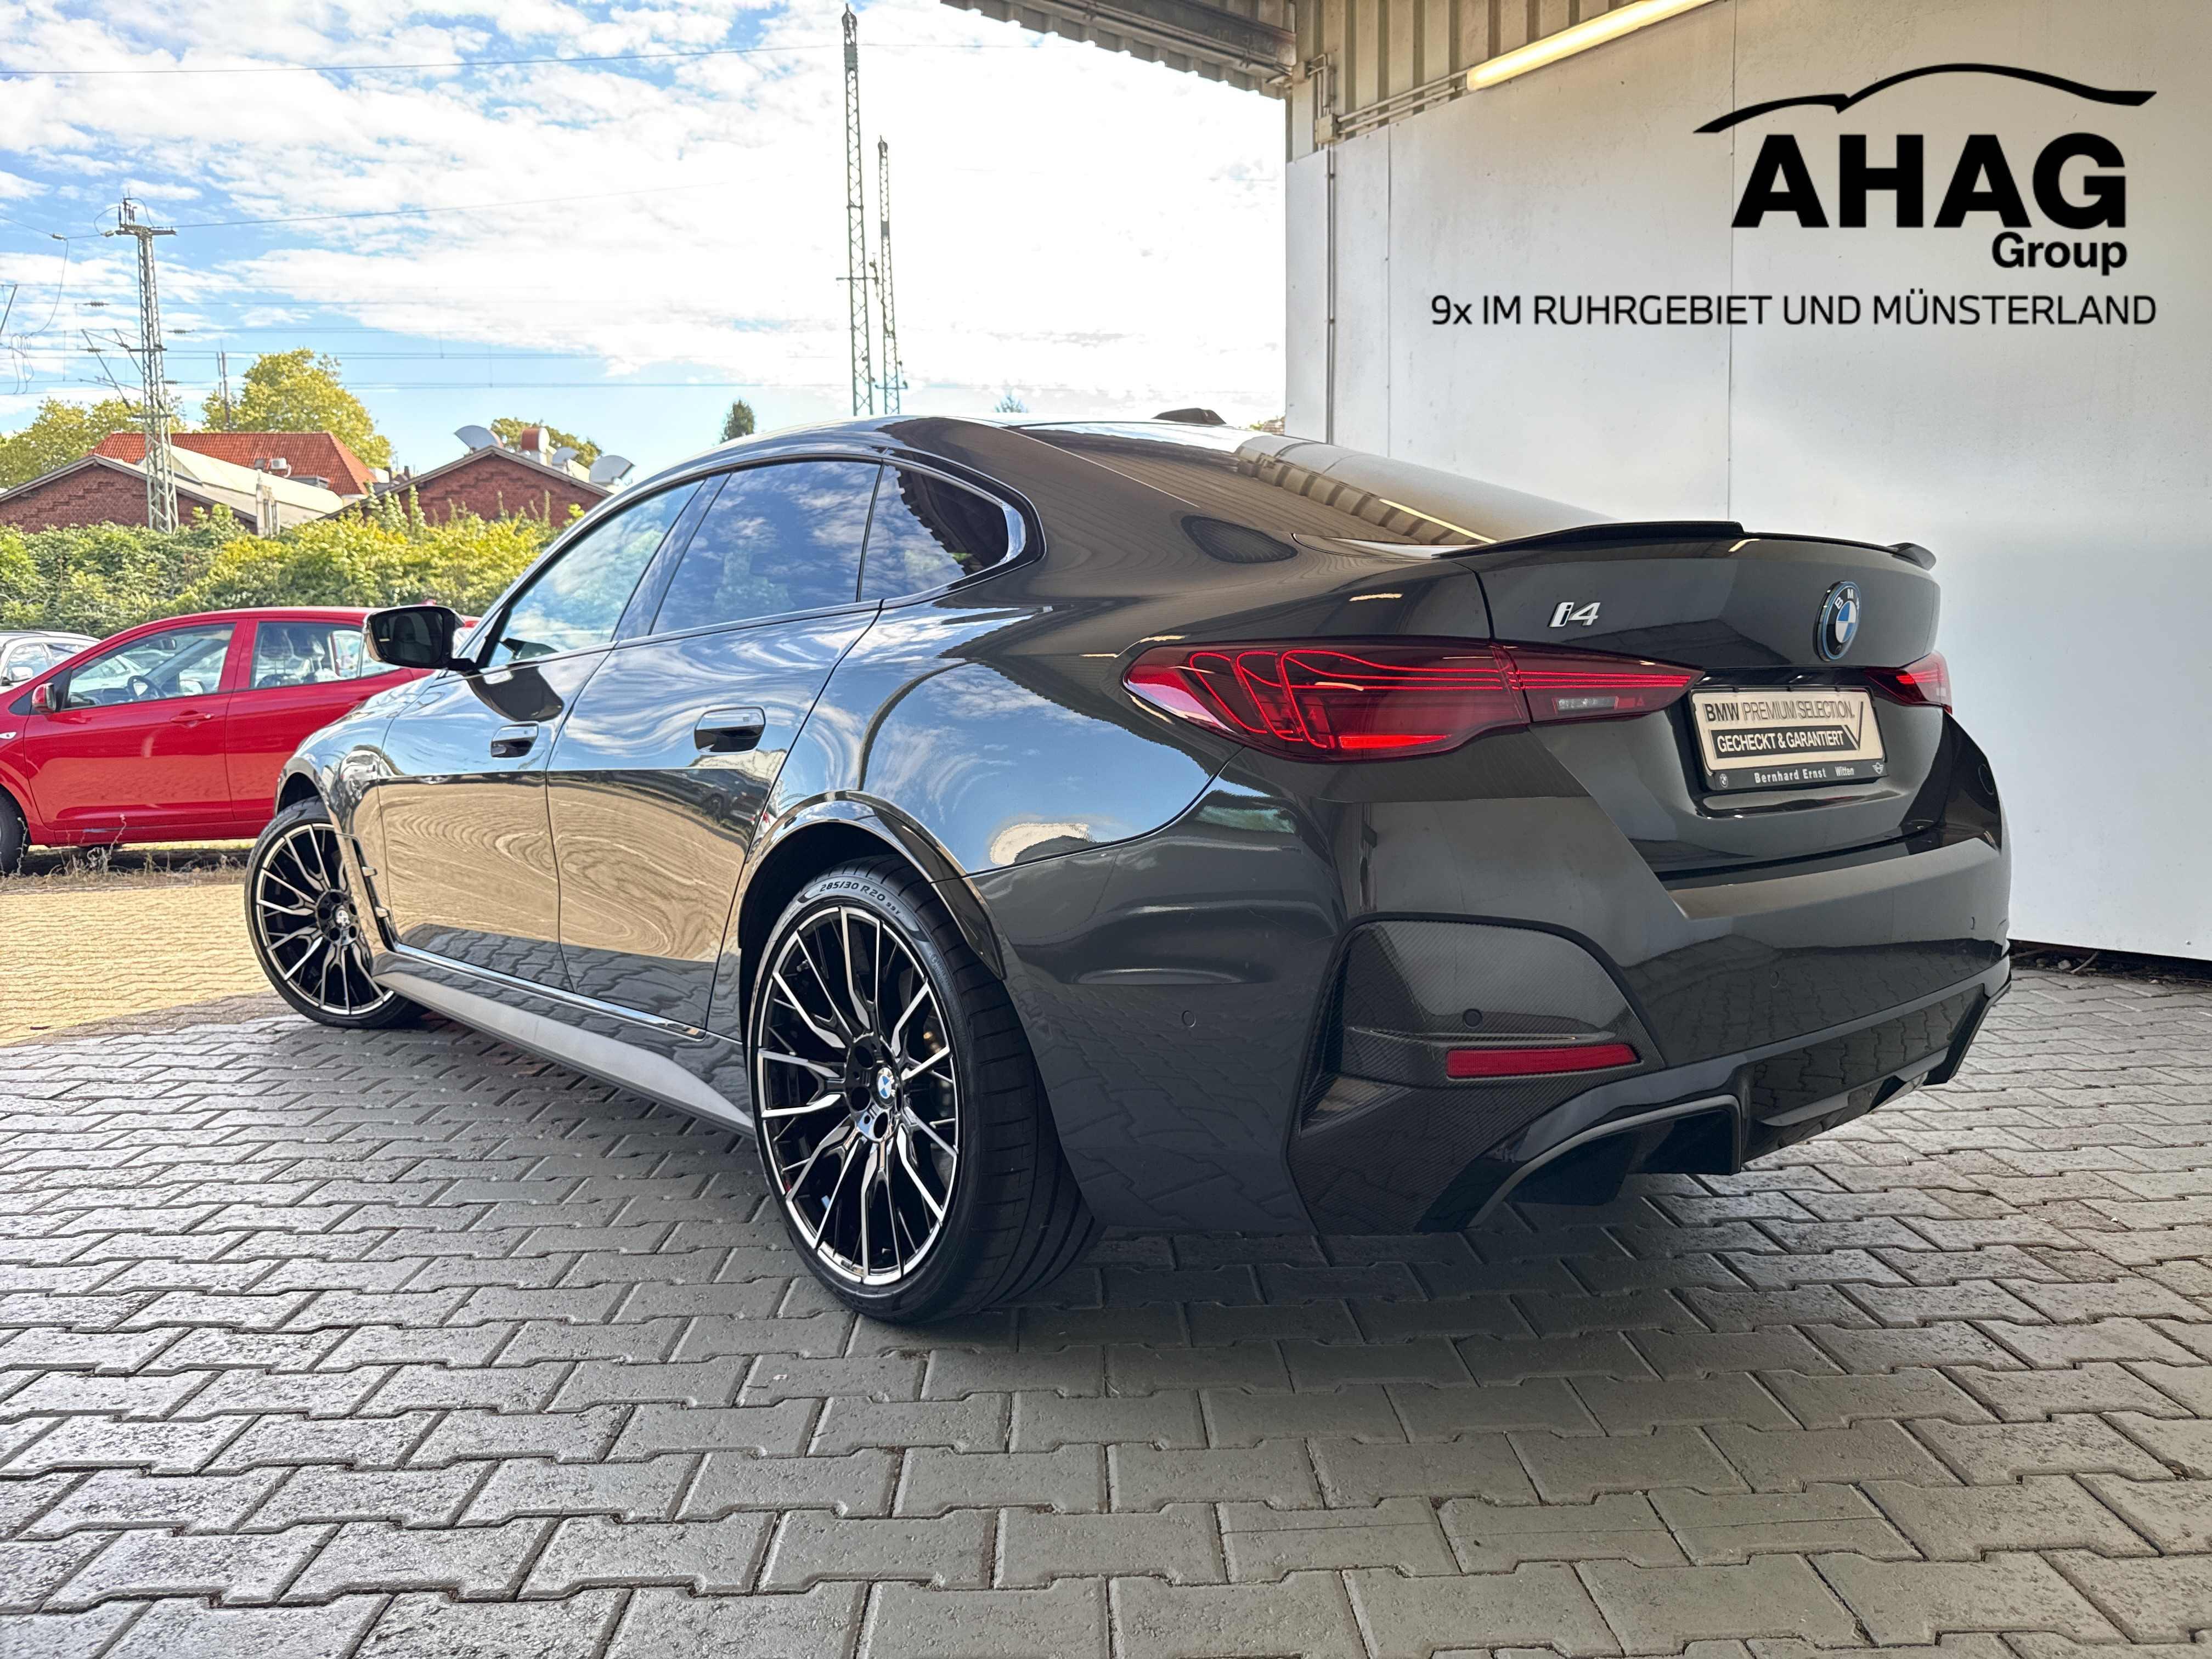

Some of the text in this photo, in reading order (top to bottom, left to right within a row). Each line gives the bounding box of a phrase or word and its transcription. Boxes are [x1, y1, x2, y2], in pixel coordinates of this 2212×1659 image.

[1548, 602, 1601, 627] i4
[1705, 702, 1740, 722] BMW
[1741, 701, 1797, 720] PREMIUM
[1717, 730, 1844, 753] GECHECKT & GARANTIERT
[1754, 766, 1855, 784] Bernhard Ernst Witten
[819, 881, 859, 893] 285/30
[859, 885, 886, 902] R20
